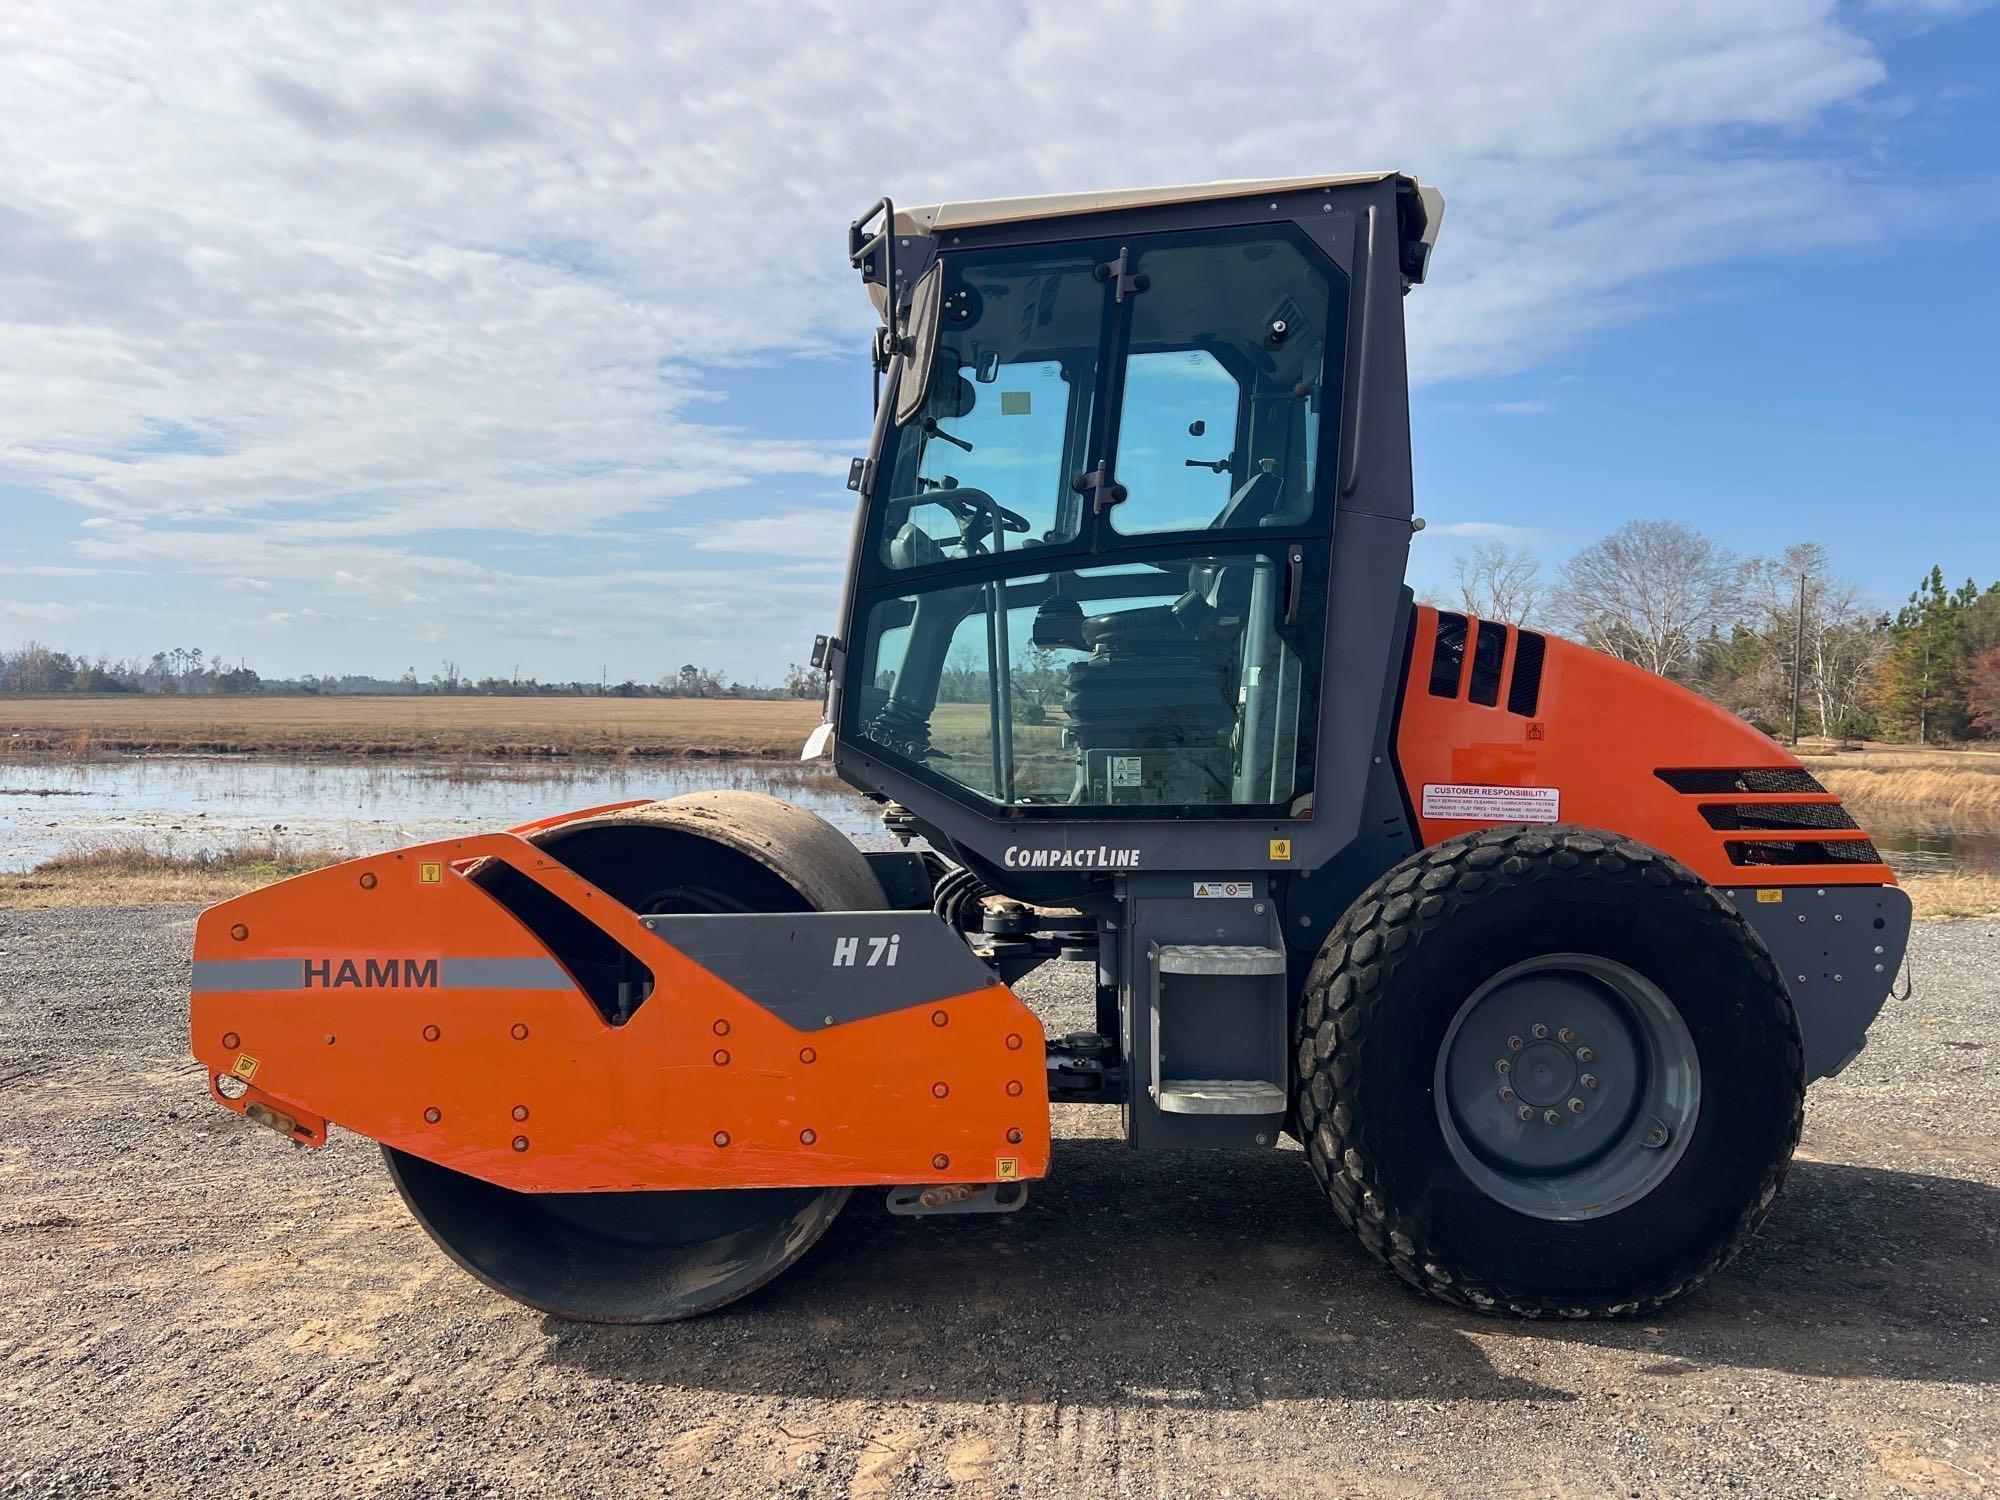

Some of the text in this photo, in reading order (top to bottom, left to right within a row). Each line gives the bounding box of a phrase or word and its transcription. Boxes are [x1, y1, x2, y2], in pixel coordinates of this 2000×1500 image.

[1434, 787, 1548, 797] CUSTOMER RESPONSIBILITY
[832, 934, 901, 966] H 7i
[304, 959, 438, 988] HAMM
